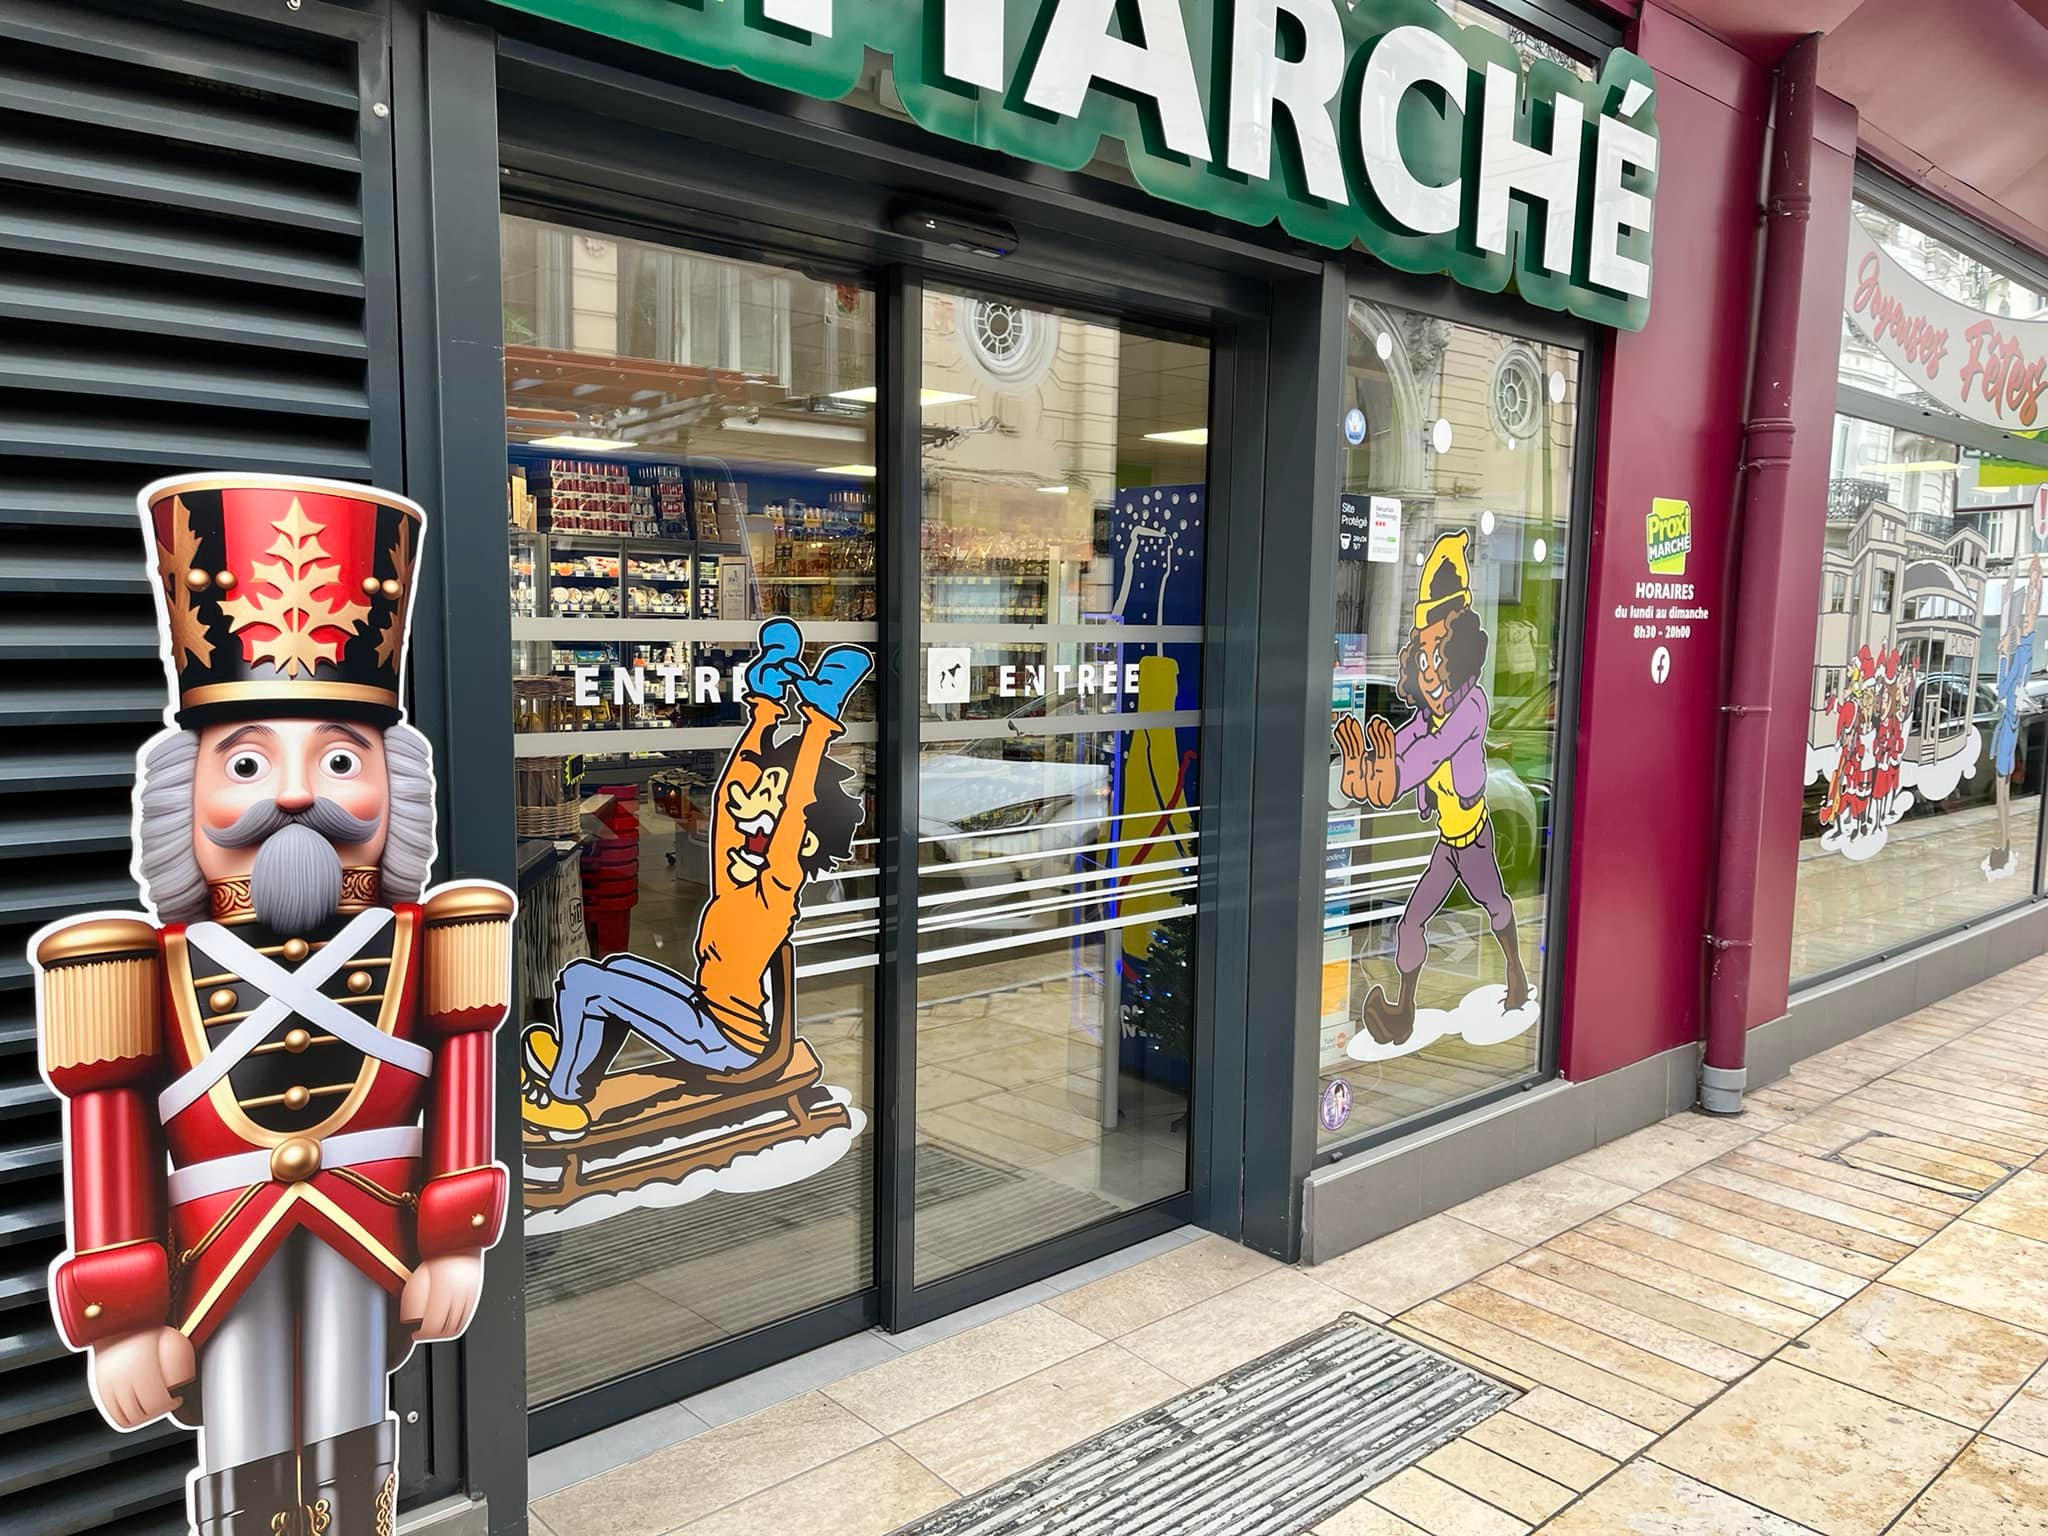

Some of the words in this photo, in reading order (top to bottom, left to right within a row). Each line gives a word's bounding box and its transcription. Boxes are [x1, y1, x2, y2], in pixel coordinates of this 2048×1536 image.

[1960, 319, 2047, 427] Fêtes
[1342, 502, 1355, 513] Site
[1648, 506, 1689, 545] Proxi
[1635, 582, 1694, 600] HORAIRES
[1615, 605, 1627, 618] du
[1630, 605, 1654, 618] lundi
[1656, 608, 1667, 618] au
[1669, 606, 1709, 619] dimanche
[1633, 625, 1656, 638] 8h30
[1665, 625, 1691, 638] 20h00
[575, 662, 751, 706] ENTRÉ
[1000, 661, 1139, 697] ENTRÉE
